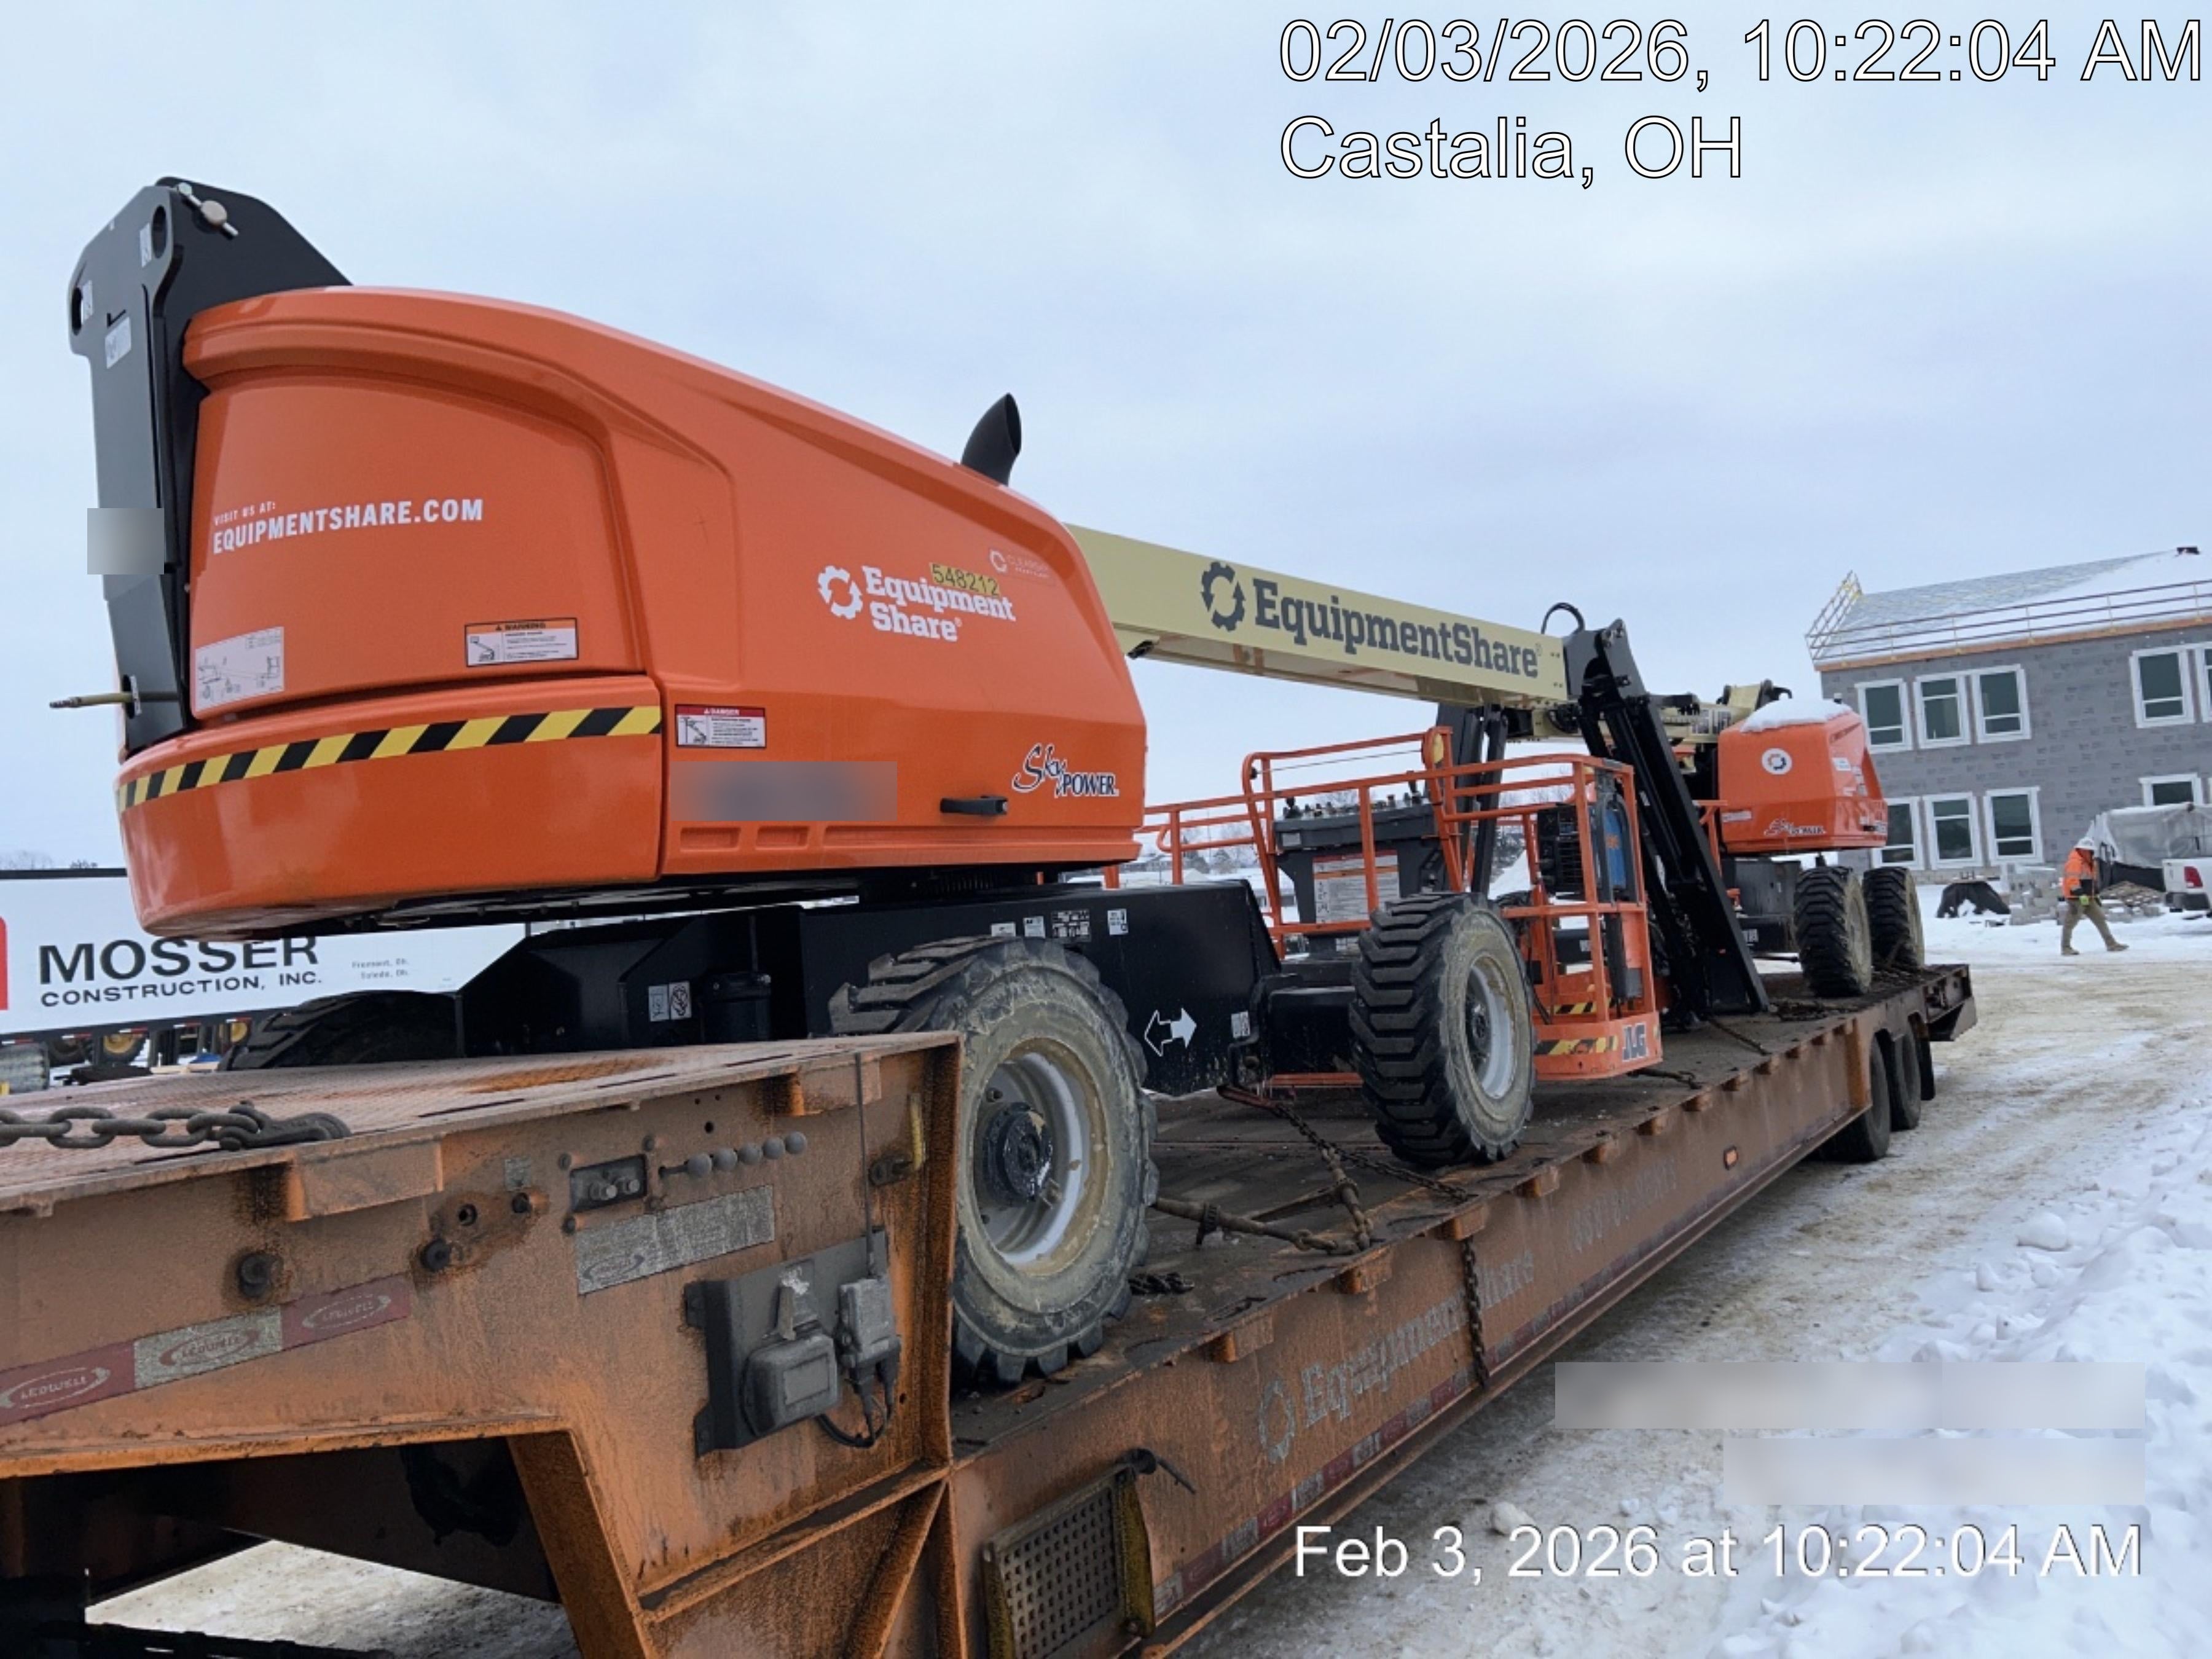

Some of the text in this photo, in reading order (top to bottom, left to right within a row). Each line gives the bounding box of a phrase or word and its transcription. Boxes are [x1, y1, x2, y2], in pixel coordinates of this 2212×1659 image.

[213, 498, 484, 554] EQUIPMENTSHARE.COM
[214, 501, 276, 526] VISIT US AT:
[862, 565, 1016, 621] Equipment
[931, 563, 1000, 596] 548212
[39, 938, 318, 985] MOSSER
[41, 971, 322, 1007] CONSTRUCTION, INC.
[1622, 1021, 1648, 1062] JLG
